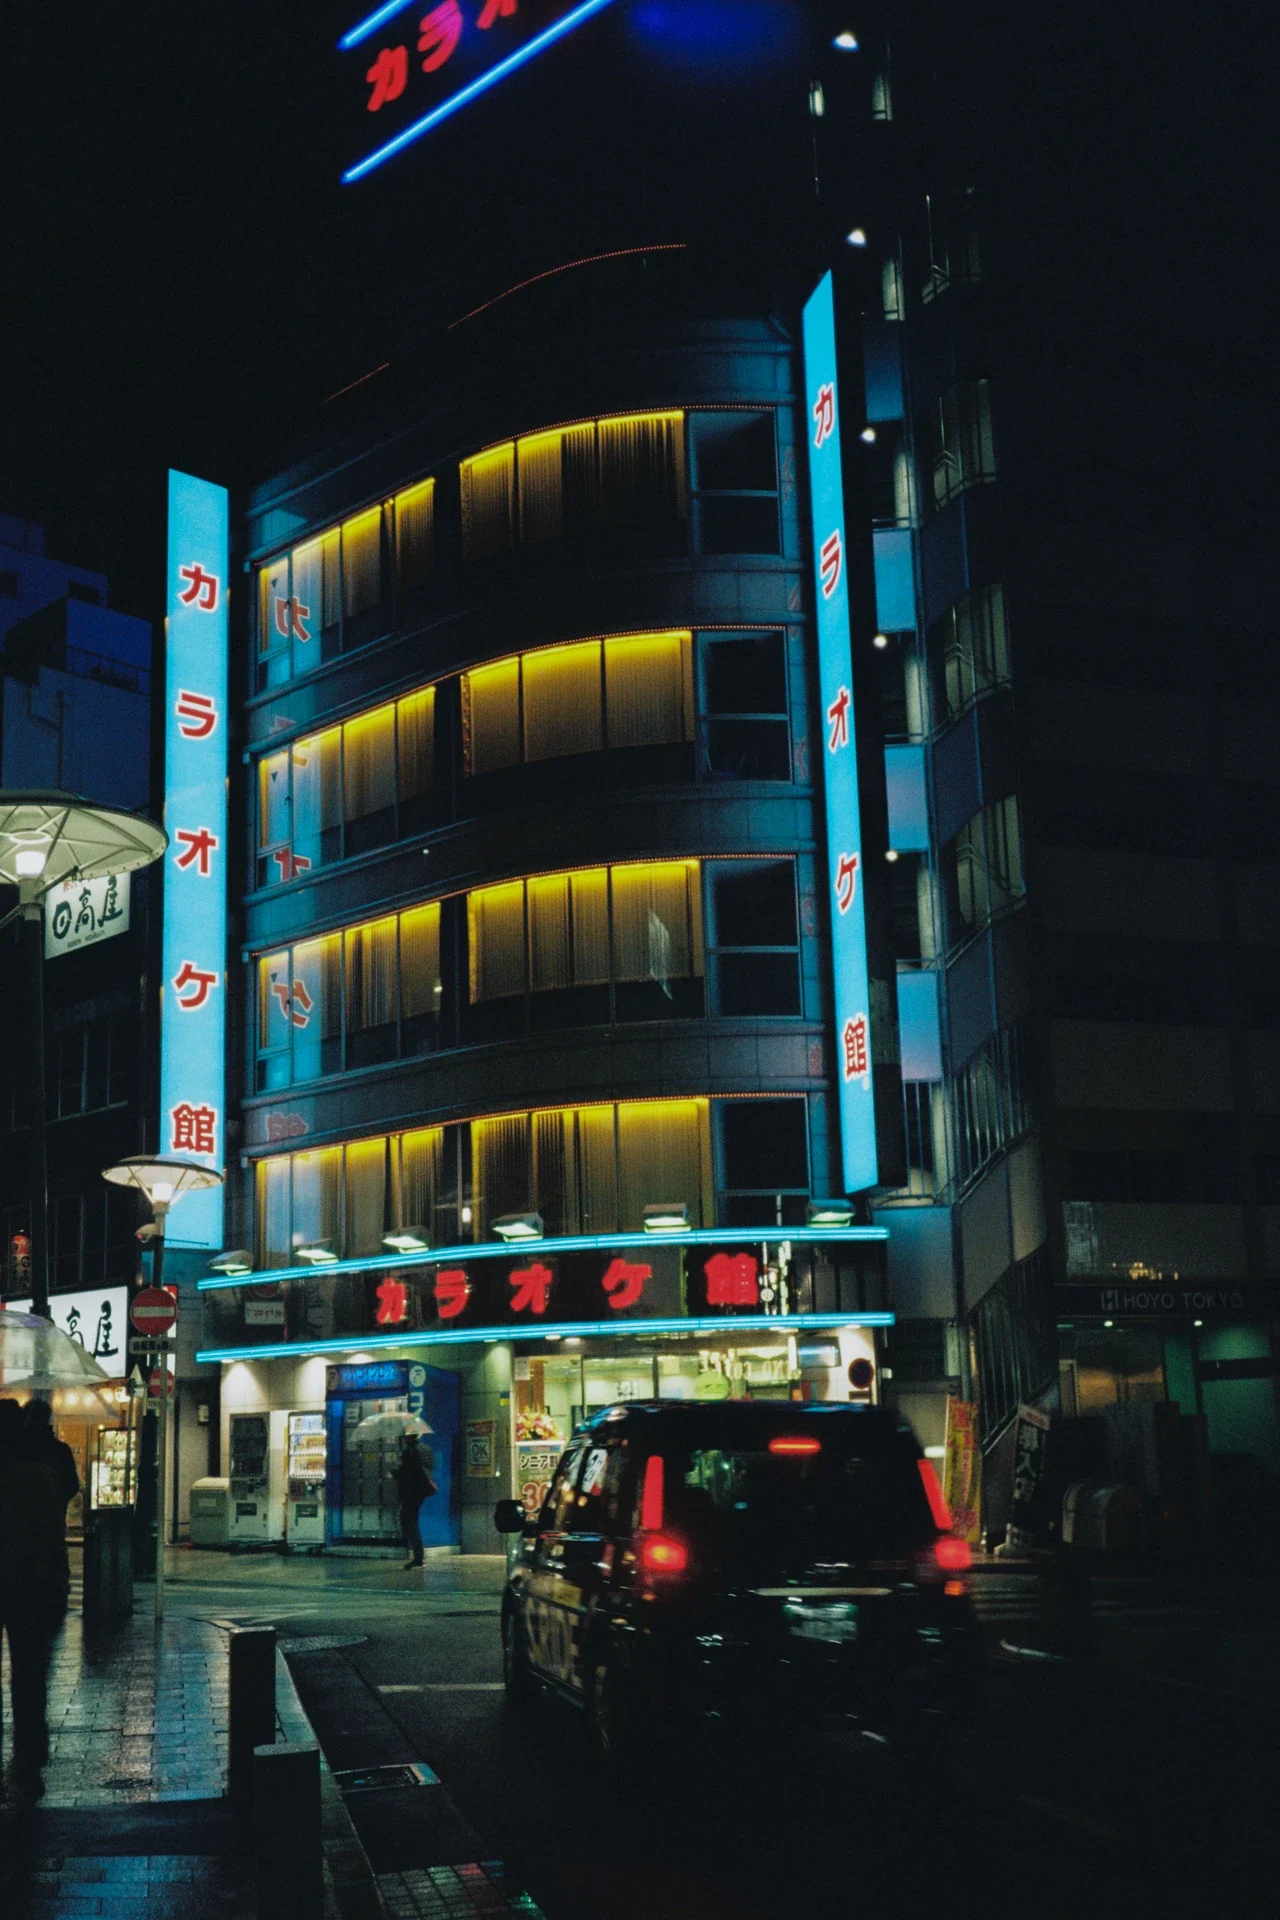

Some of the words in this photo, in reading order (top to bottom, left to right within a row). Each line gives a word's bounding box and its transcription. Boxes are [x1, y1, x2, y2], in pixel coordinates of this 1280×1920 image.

[812, 384, 870, 1075] カラオケ館
[172, 564, 219, 1154] カラオケ館
[52, 876, 123, 940] 日高屋
[376, 1254, 758, 1325] カラオケ館
[1123, 1292, 1174, 1309] HOYO
[1181, 1292, 1243, 1309] TOKYO
